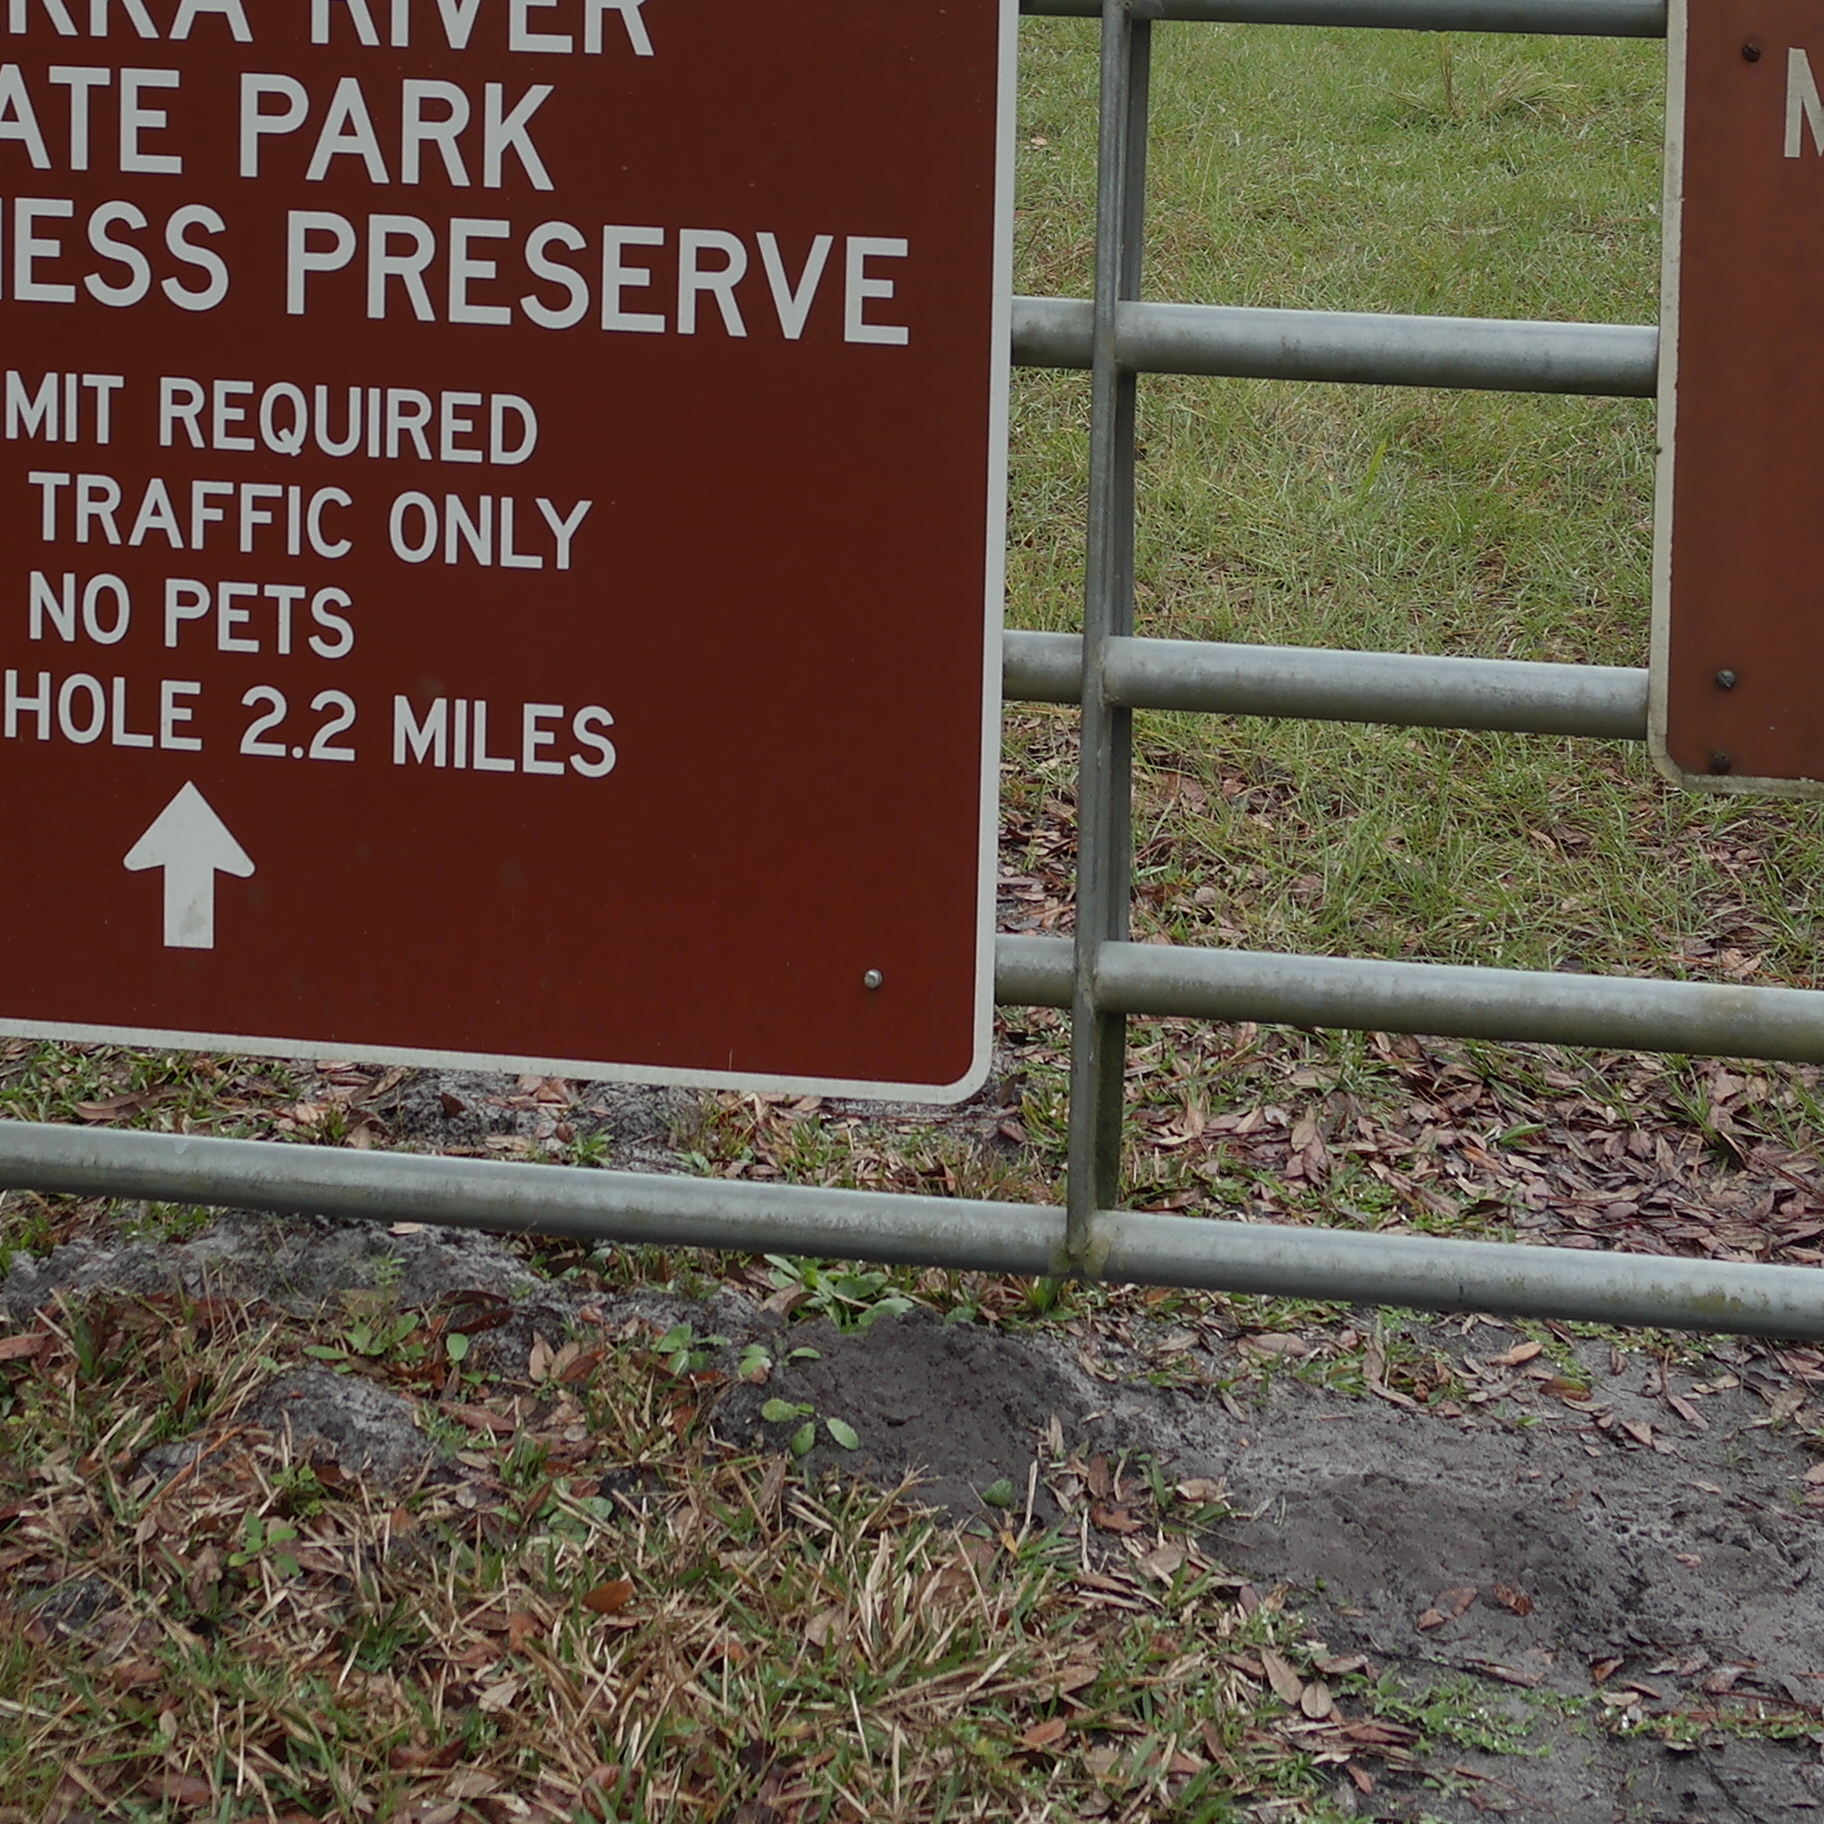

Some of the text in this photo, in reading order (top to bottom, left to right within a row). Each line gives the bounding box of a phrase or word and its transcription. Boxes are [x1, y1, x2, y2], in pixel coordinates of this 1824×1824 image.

[241, 73, 554, 190] PARK
[287, 211, 908, 345] PRESERVE
[160, 377, 537, 464] REQUIRED
[29, 472, 352, 558] TRAFFIC
[390, 492, 592, 569] ONLY
[30, 571, 353, 658] NO PETS
[5, 670, 200, 750] HOLE
[240, 686, 355, 761] 2.2
[394, 695, 616, 777] MILES
